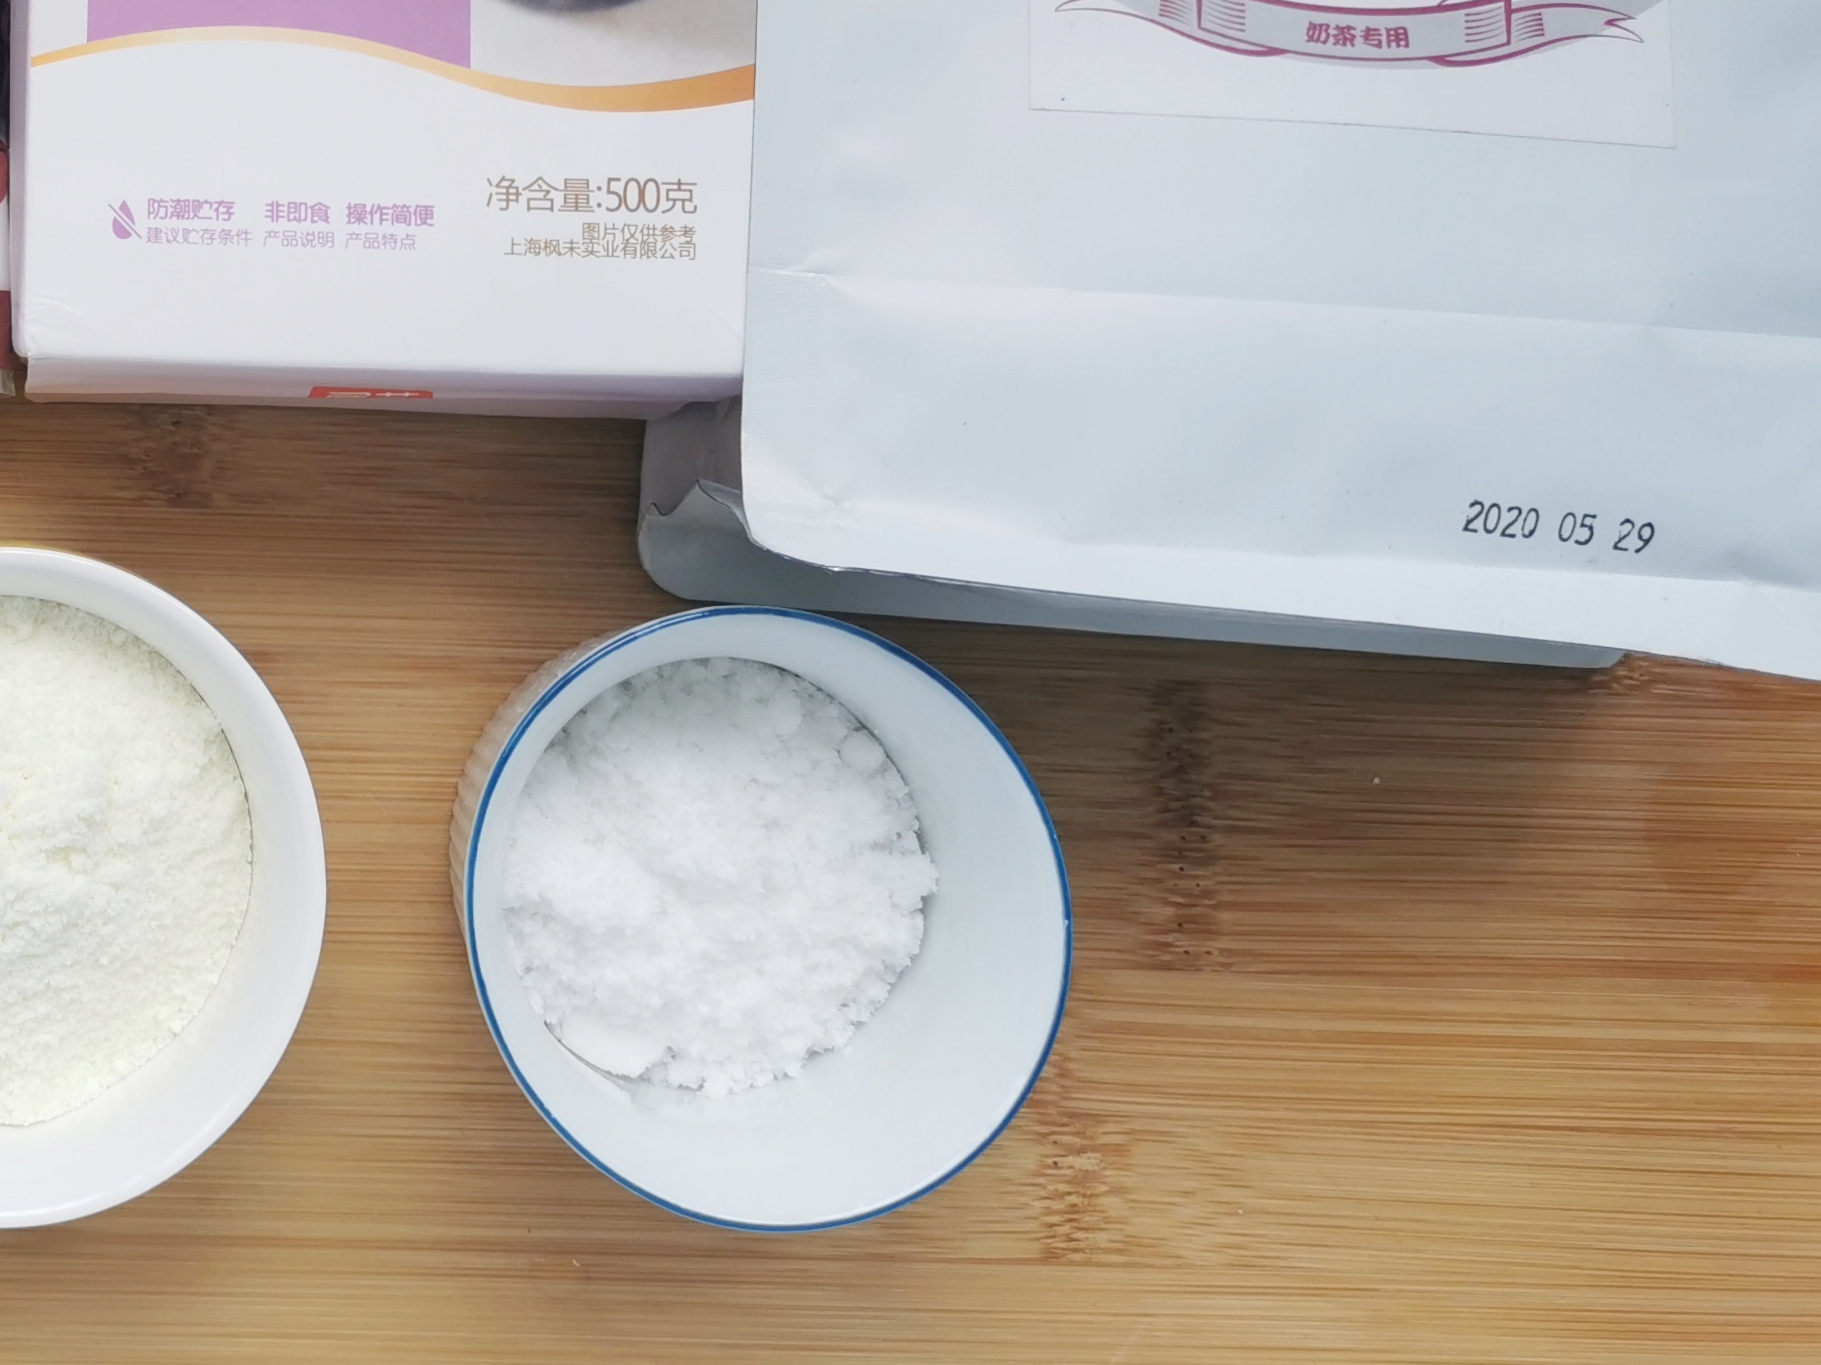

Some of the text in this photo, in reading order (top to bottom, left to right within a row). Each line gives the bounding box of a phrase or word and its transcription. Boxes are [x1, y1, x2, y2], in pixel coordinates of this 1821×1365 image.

[1305, 20, 1410, 49] 奶茶专用
[485, 174, 698, 215] 净含量:500克
[146, 197, 435, 227] 防潮贮存 非即食 操作简便
[145, 226, 417, 251] 建议贮存条件 产品说明 产品特点
[581, 221, 698, 244] 图片仅供参考
[503, 236, 698, 261] 上海枫未实业有限公司
[1463, 499, 1656, 554] 2020 05 29
